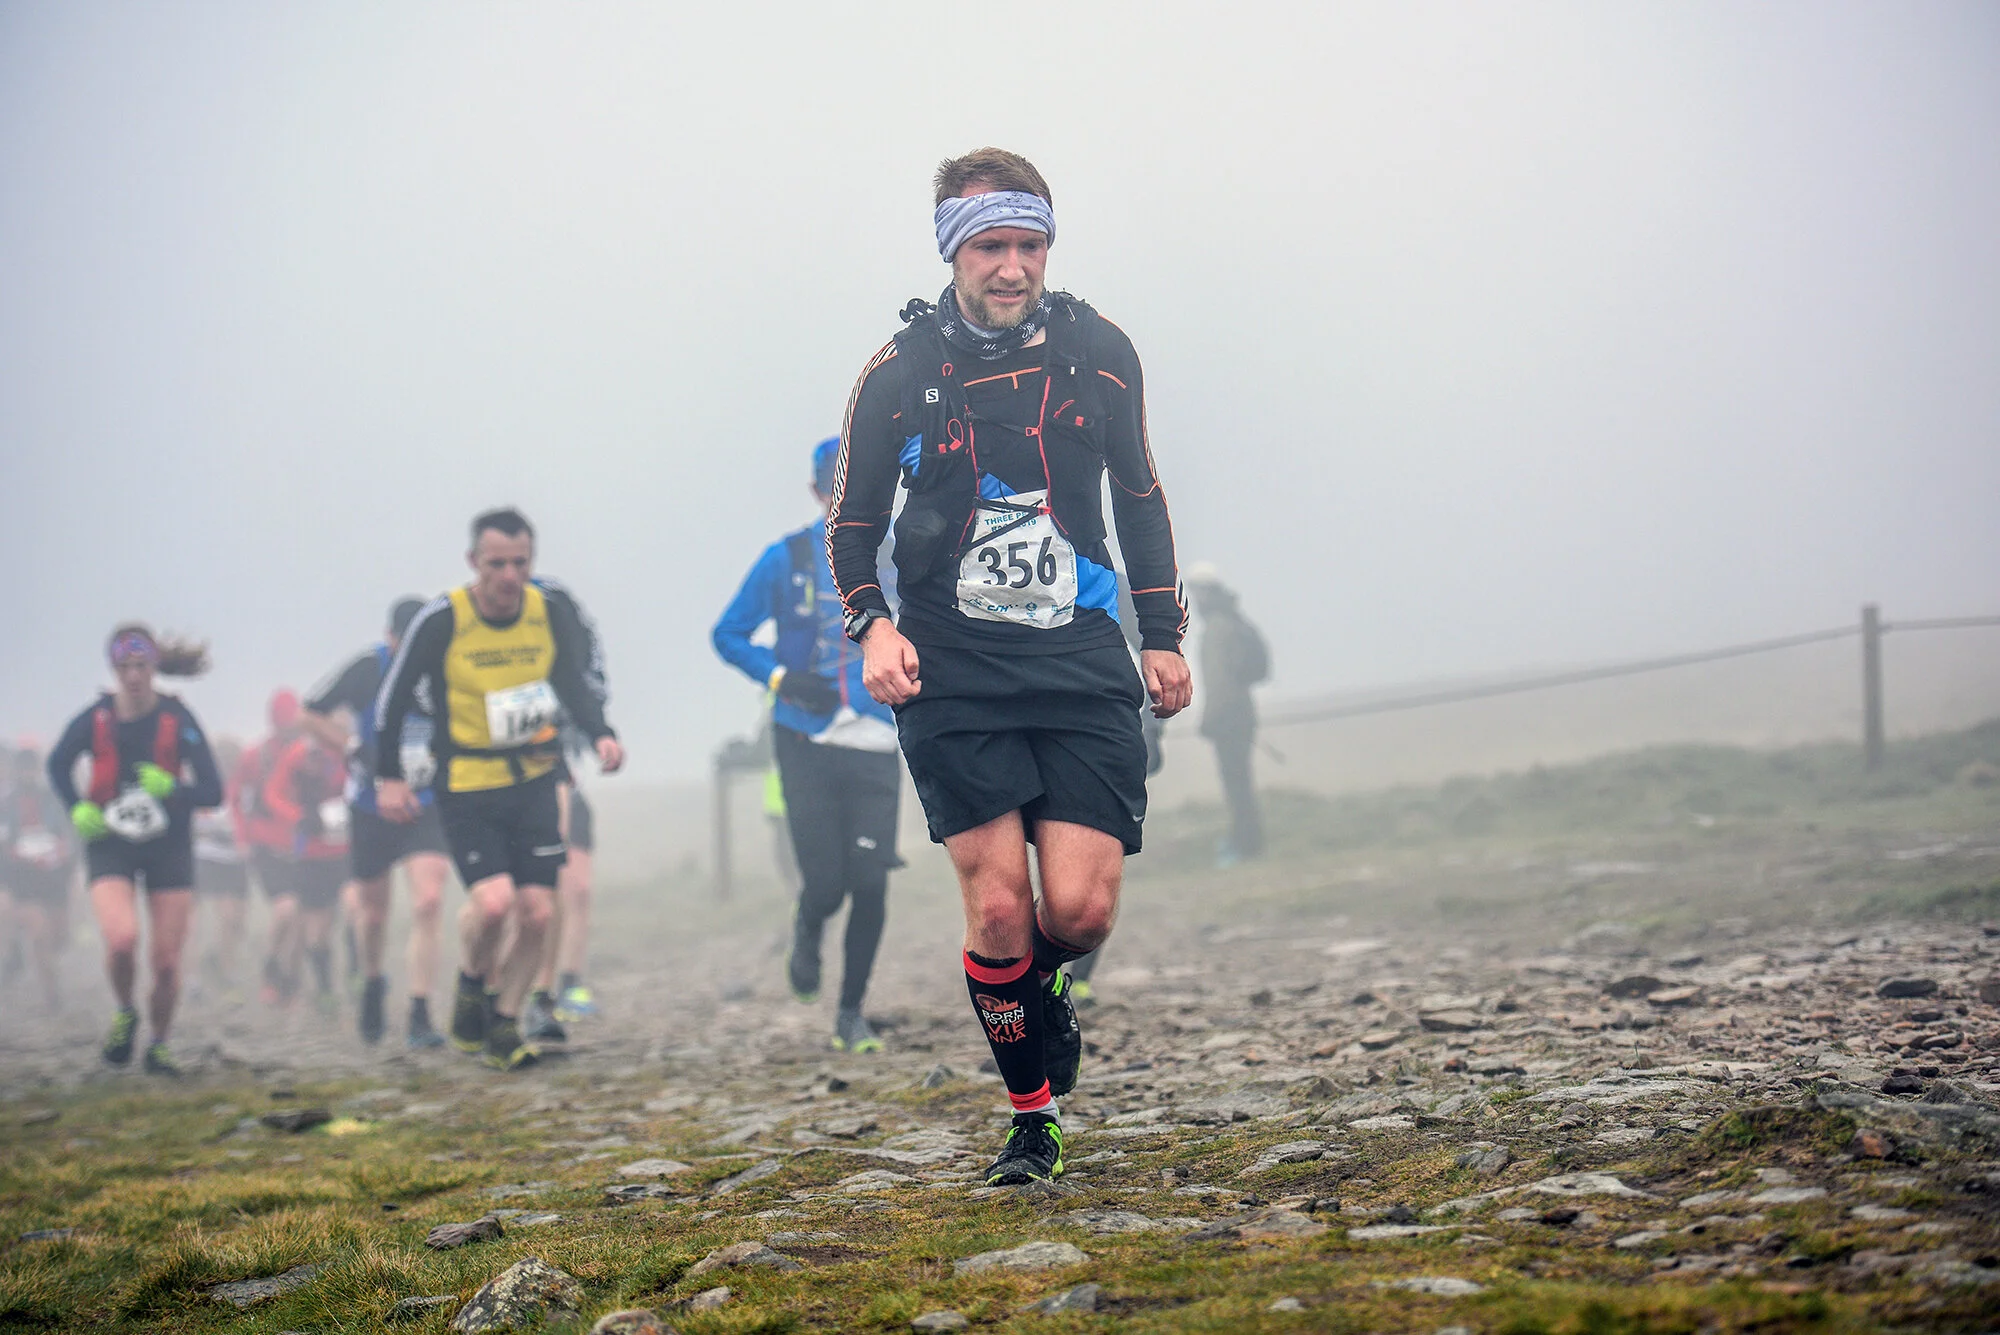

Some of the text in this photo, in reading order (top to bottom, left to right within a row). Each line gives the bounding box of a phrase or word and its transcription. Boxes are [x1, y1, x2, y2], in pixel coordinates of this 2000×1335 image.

[927, 389, 938, 402] S
[984, 513, 1014, 525] THREE
[978, 536, 1057, 588] 356
[982, 1005, 1024, 1021] BORN
[1001, 1014, 1024, 1025] RUN
[986, 1018, 1025, 1035] VIE
[988, 1031, 1027, 1043] NNA
